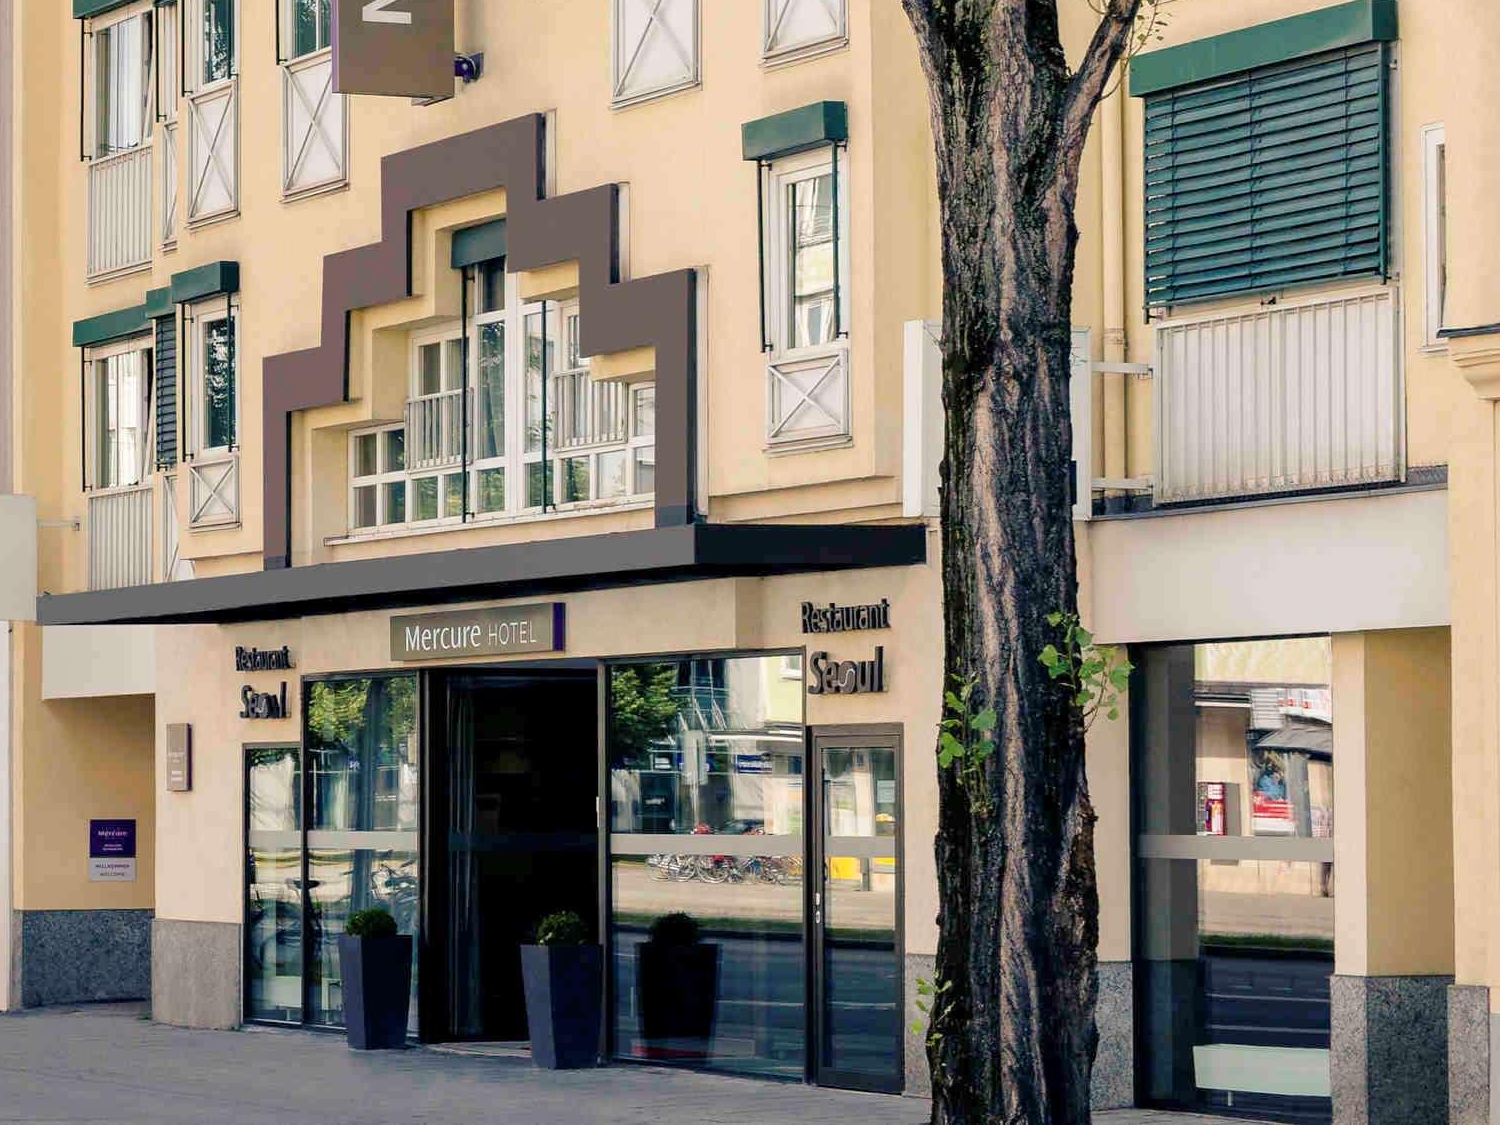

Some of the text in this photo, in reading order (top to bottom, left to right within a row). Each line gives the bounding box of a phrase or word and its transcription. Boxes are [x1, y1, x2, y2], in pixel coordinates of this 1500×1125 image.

[801, 598, 890, 634] Restaurant
[405, 619, 537, 652] Mercure HOTEL
[236, 645, 296, 672] Restaurant
[808, 646, 885, 694] Seoul
[240, 681, 289, 719] Seoul
